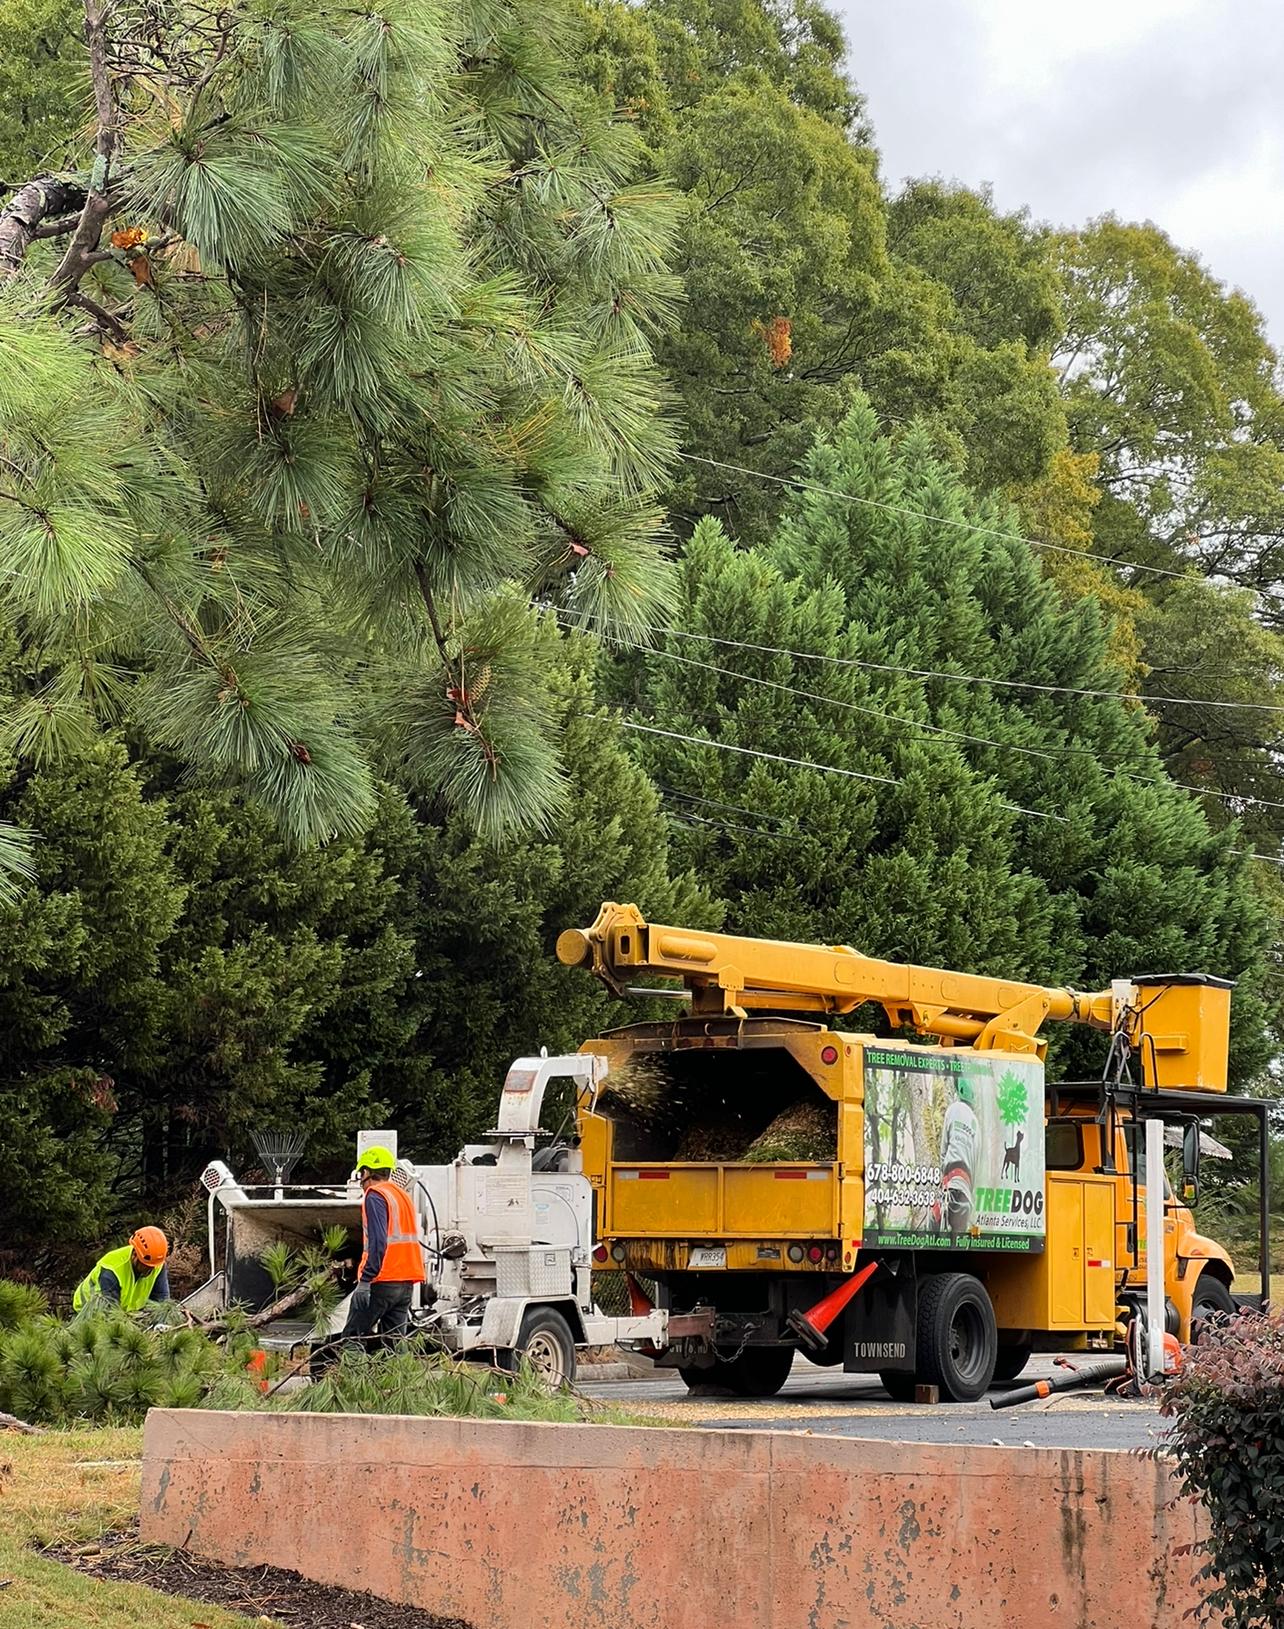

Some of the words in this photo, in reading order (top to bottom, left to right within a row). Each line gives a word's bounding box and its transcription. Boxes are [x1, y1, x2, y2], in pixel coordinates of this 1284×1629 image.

[867, 1051, 885, 1064] TREE
[886, 1053, 917, 1067] REMOVAL
[918, 1057, 946, 1071] EXPERTS
[867, 1163, 940, 1185] 678-800-6848
[871, 1187, 936, 1206] 404-632-3638
[976, 1187, 1044, 1216] TREEDOG
[976, 1214, 1000, 1227] Atlanta
[956, 1235, 970, 1250] Fully
[1001, 1236, 1030, 1249] Licensed
[854, 1342, 906, 1358] TOWNSEND
